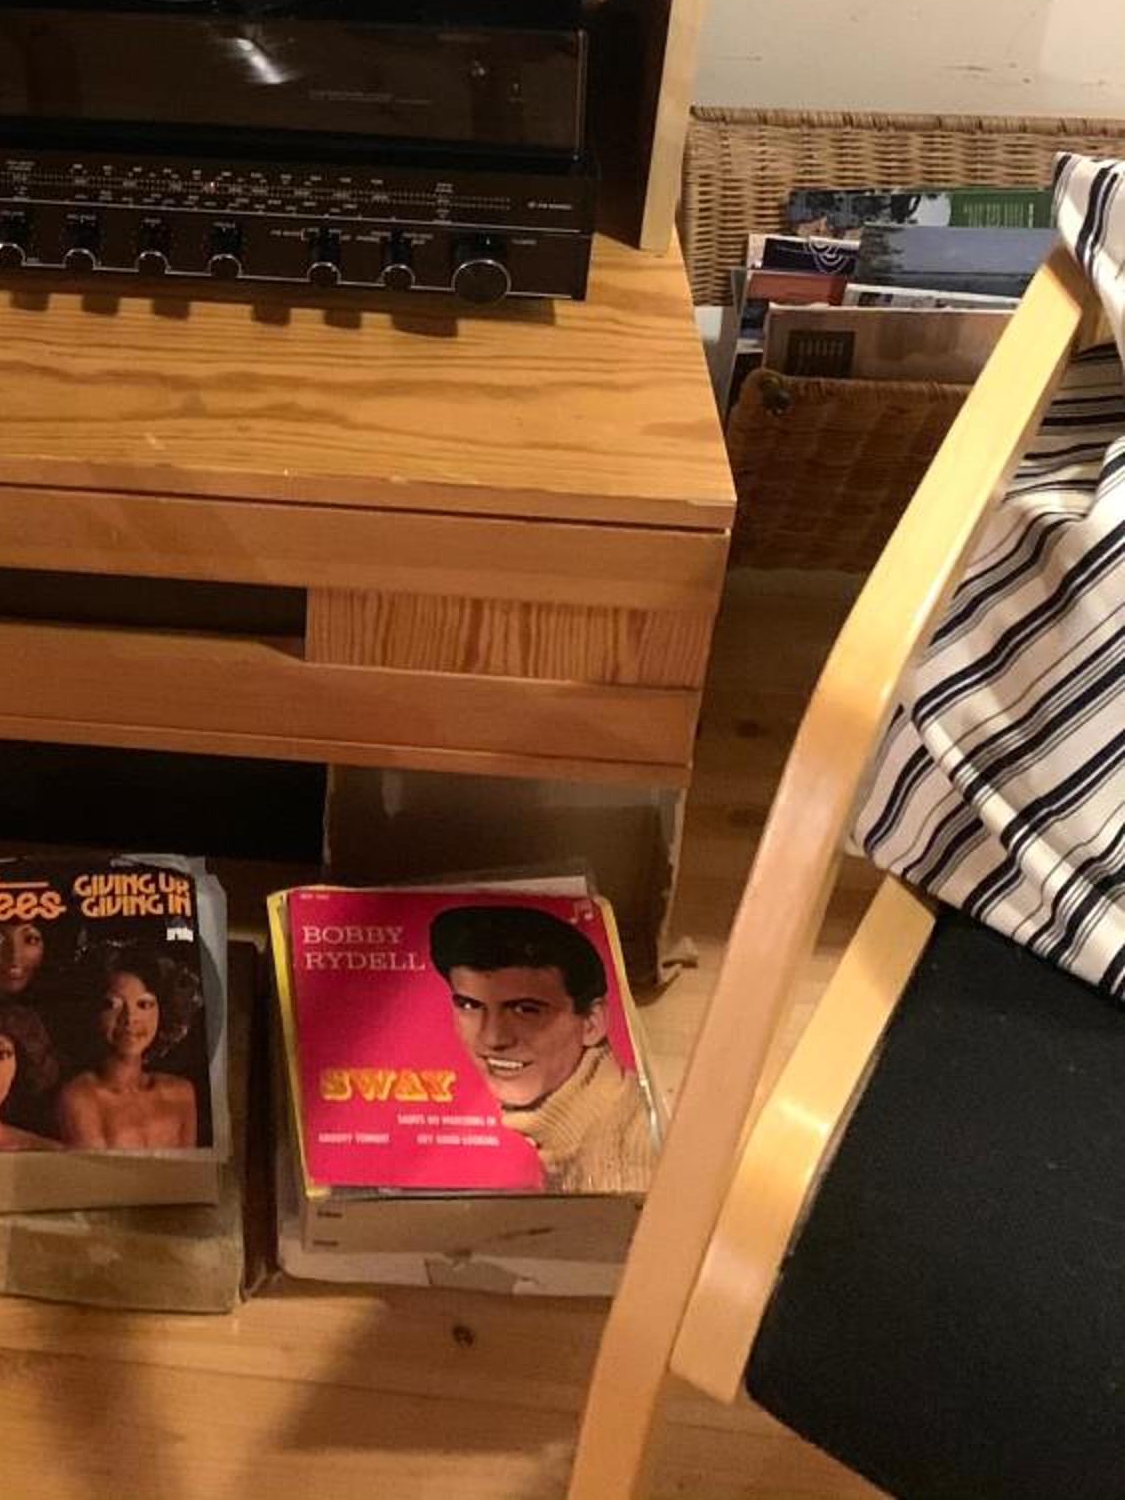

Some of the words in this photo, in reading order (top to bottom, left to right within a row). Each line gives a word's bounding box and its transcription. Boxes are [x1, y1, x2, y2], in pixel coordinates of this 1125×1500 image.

[74, 873, 153, 897] GIVING
[158, 873, 191, 895] UP
[81, 894, 163, 917] GIVING
[167, 894, 193, 917] IN
[302, 925, 404, 945] BOBBY
[304, 952, 426, 971] RYDELL
[321, 1068, 457, 1102] SWAY
